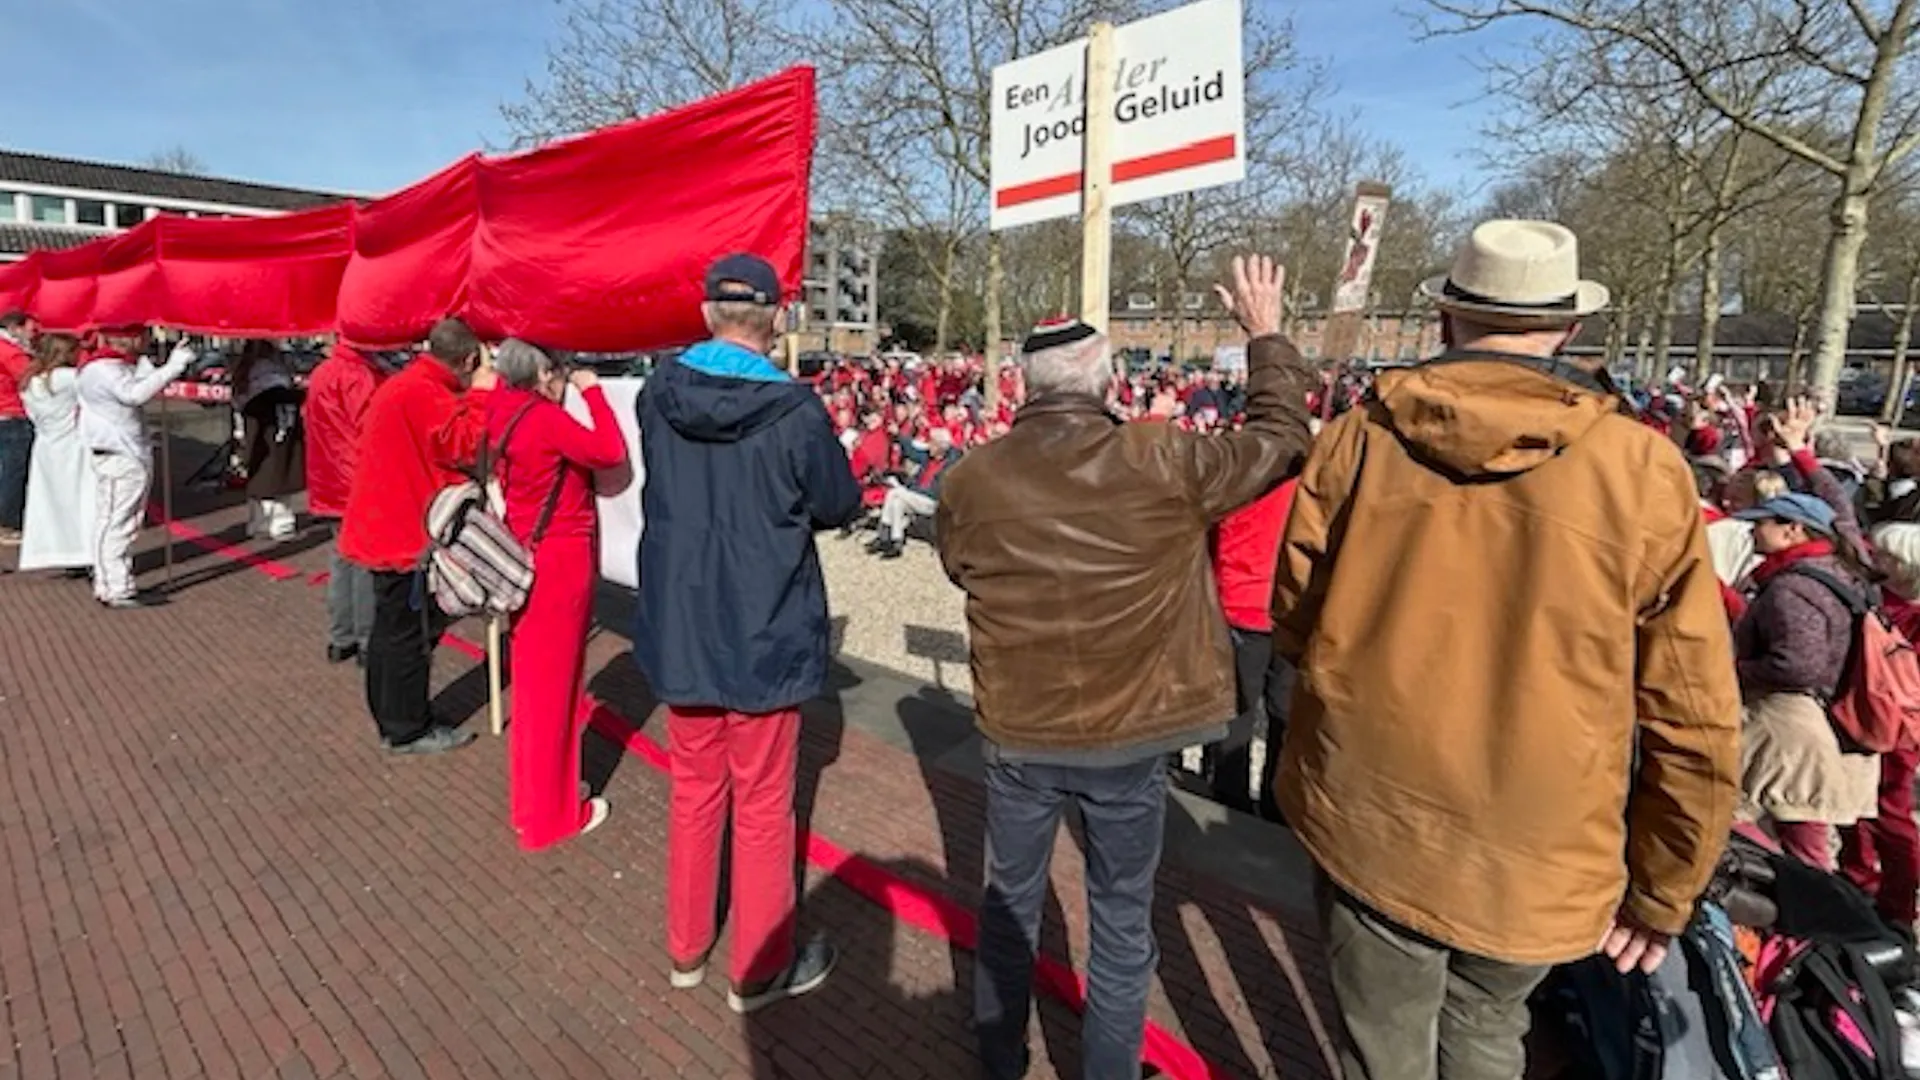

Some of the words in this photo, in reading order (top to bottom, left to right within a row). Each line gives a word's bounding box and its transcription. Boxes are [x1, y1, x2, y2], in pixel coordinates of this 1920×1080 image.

[1006, 83, 1049, 110] Een
[1021, 115, 1086, 158] Jood
[1114, 71, 1223, 123] Geluid
